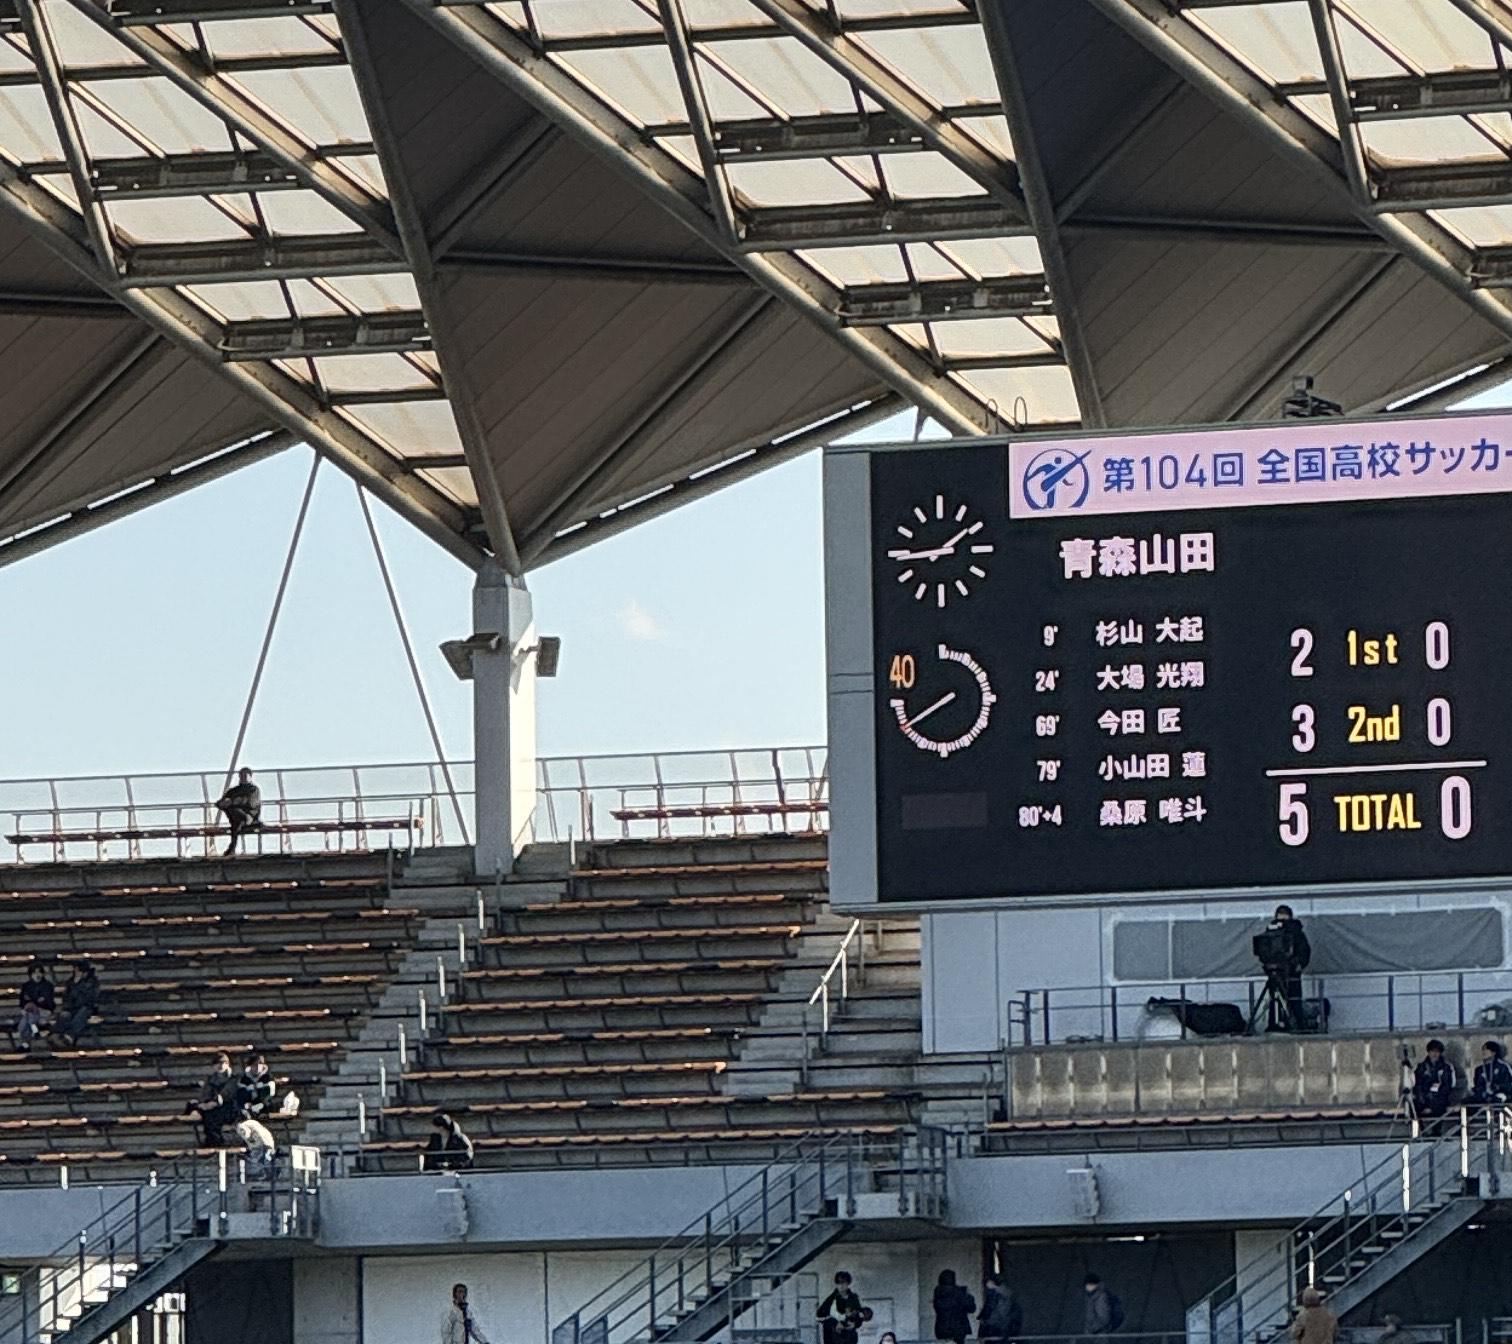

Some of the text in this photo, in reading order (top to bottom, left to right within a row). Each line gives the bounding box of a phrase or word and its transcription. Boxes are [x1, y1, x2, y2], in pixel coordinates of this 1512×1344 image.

[1103, 453, 1243, 492] 第104回
[1059, 533, 1214, 579] 青森山田
[1096, 619, 1142, 646] 杉山
[1156, 617, 1203, 642] 大起
[1291, 622, 1449, 676] 2 1st 0
[889, 655, 916, 689] 40
[1098, 709, 1144, 735] 今田
[1158, 708, 1181, 733] 匠
[1292, 698, 1450, 752] 3 2nd 0
[1099, 754, 1169, 780] 小山田
[1100, 800, 1146, 826] 桑原
[1279, 776, 1471, 845] 5 TOTAL 0
